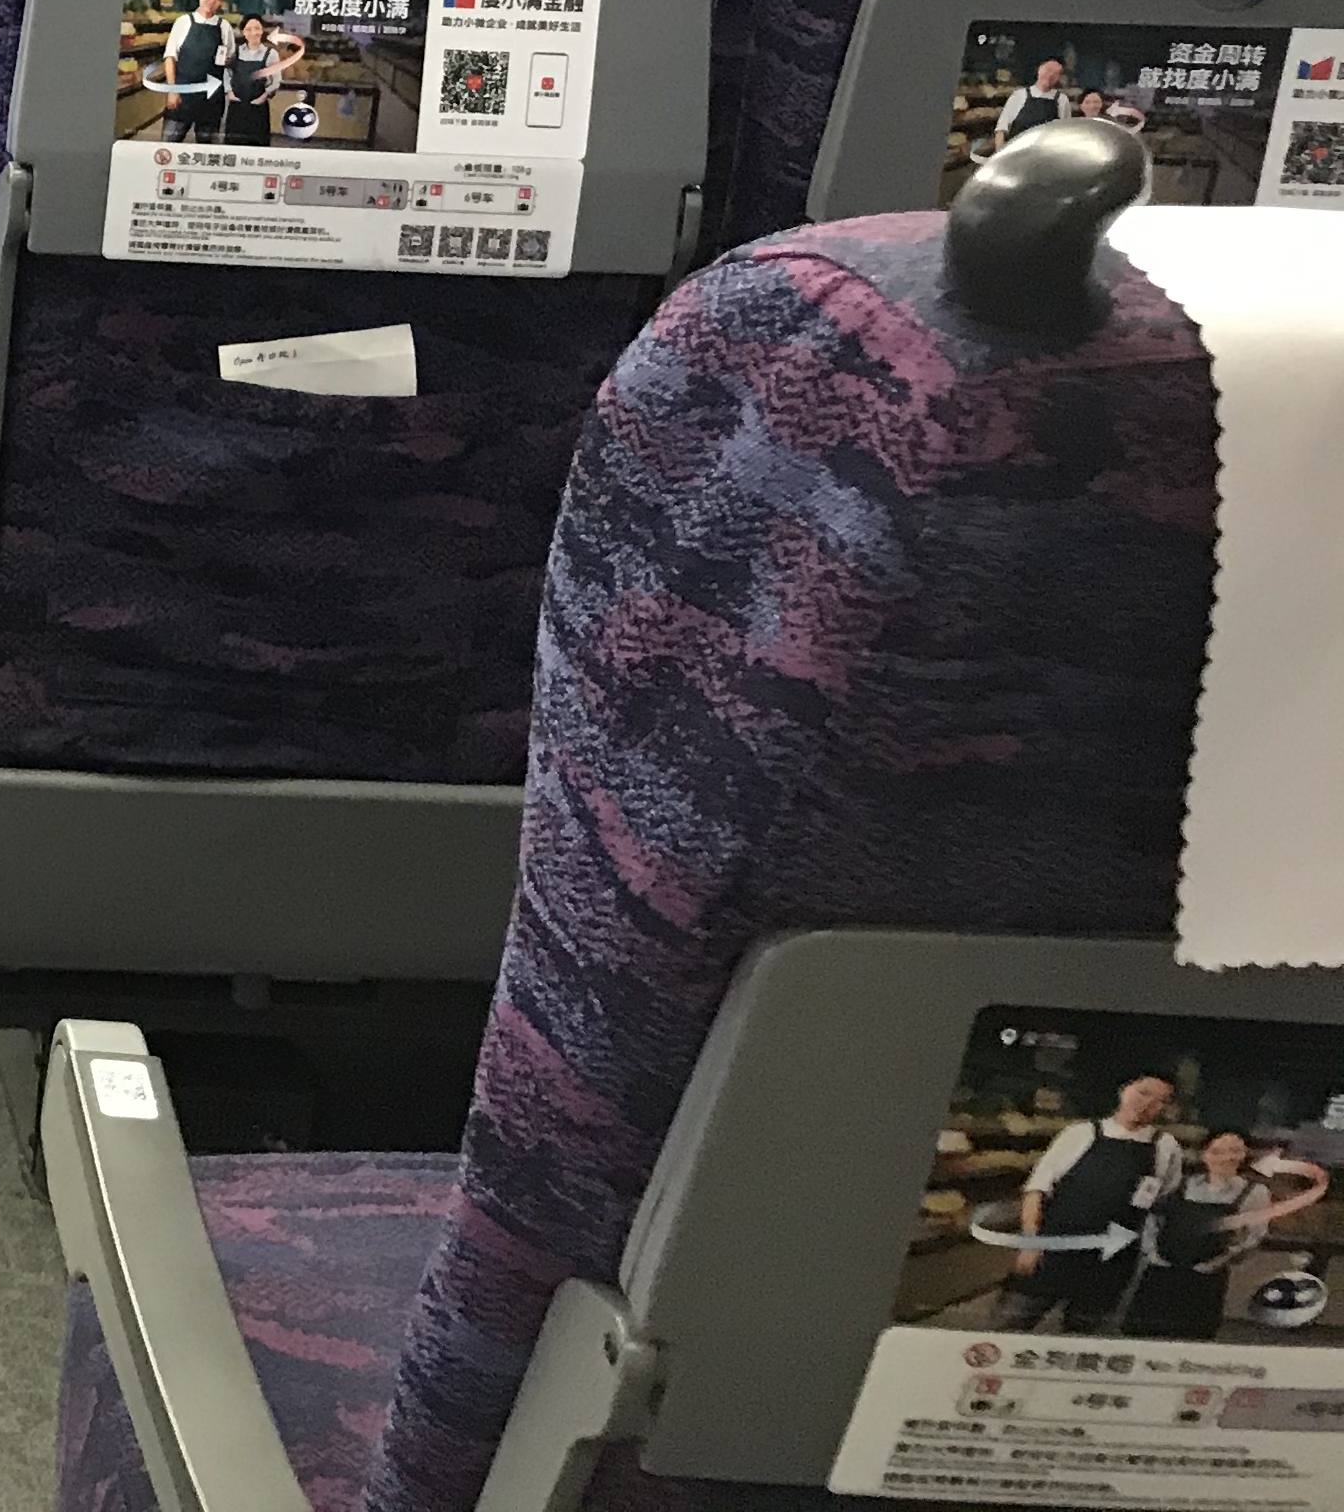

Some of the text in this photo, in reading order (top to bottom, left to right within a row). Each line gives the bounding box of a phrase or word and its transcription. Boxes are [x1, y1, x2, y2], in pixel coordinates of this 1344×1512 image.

[1168, 42, 1267, 67] 资金周转
[1137, 66, 1262, 91] 就找度小满
